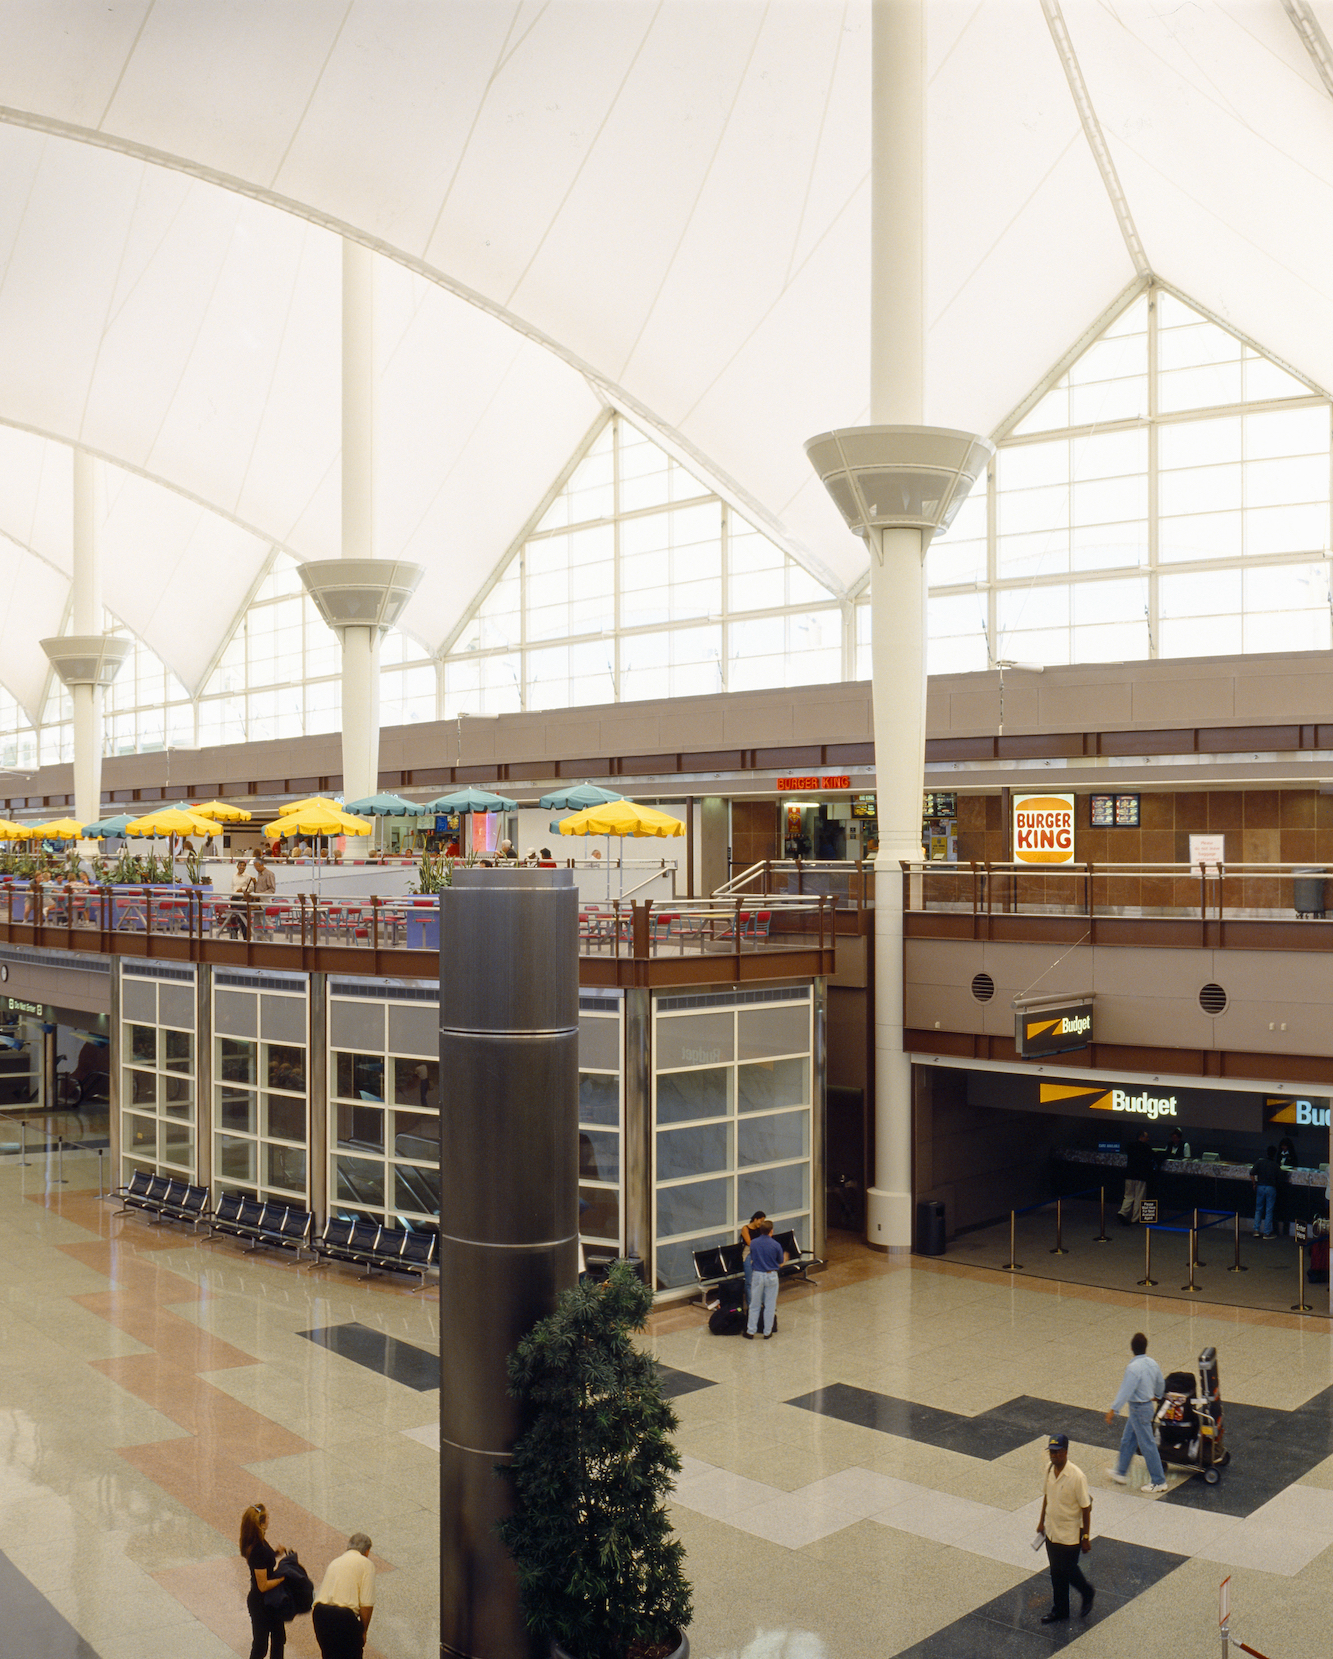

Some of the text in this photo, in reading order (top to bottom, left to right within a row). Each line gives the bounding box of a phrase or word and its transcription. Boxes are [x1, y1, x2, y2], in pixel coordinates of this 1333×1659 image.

[776, 775, 850, 790] BURGER KING
[1016, 812, 1072, 828] BURGER
[1018, 829, 1072, 848] KING
[14, 1000, 20, 1009] Do
[27, 1003, 36, 1013] Enter
[1062, 1015, 1090, 1035] Budget
[1112, 1089, 1177, 1119] Budget
